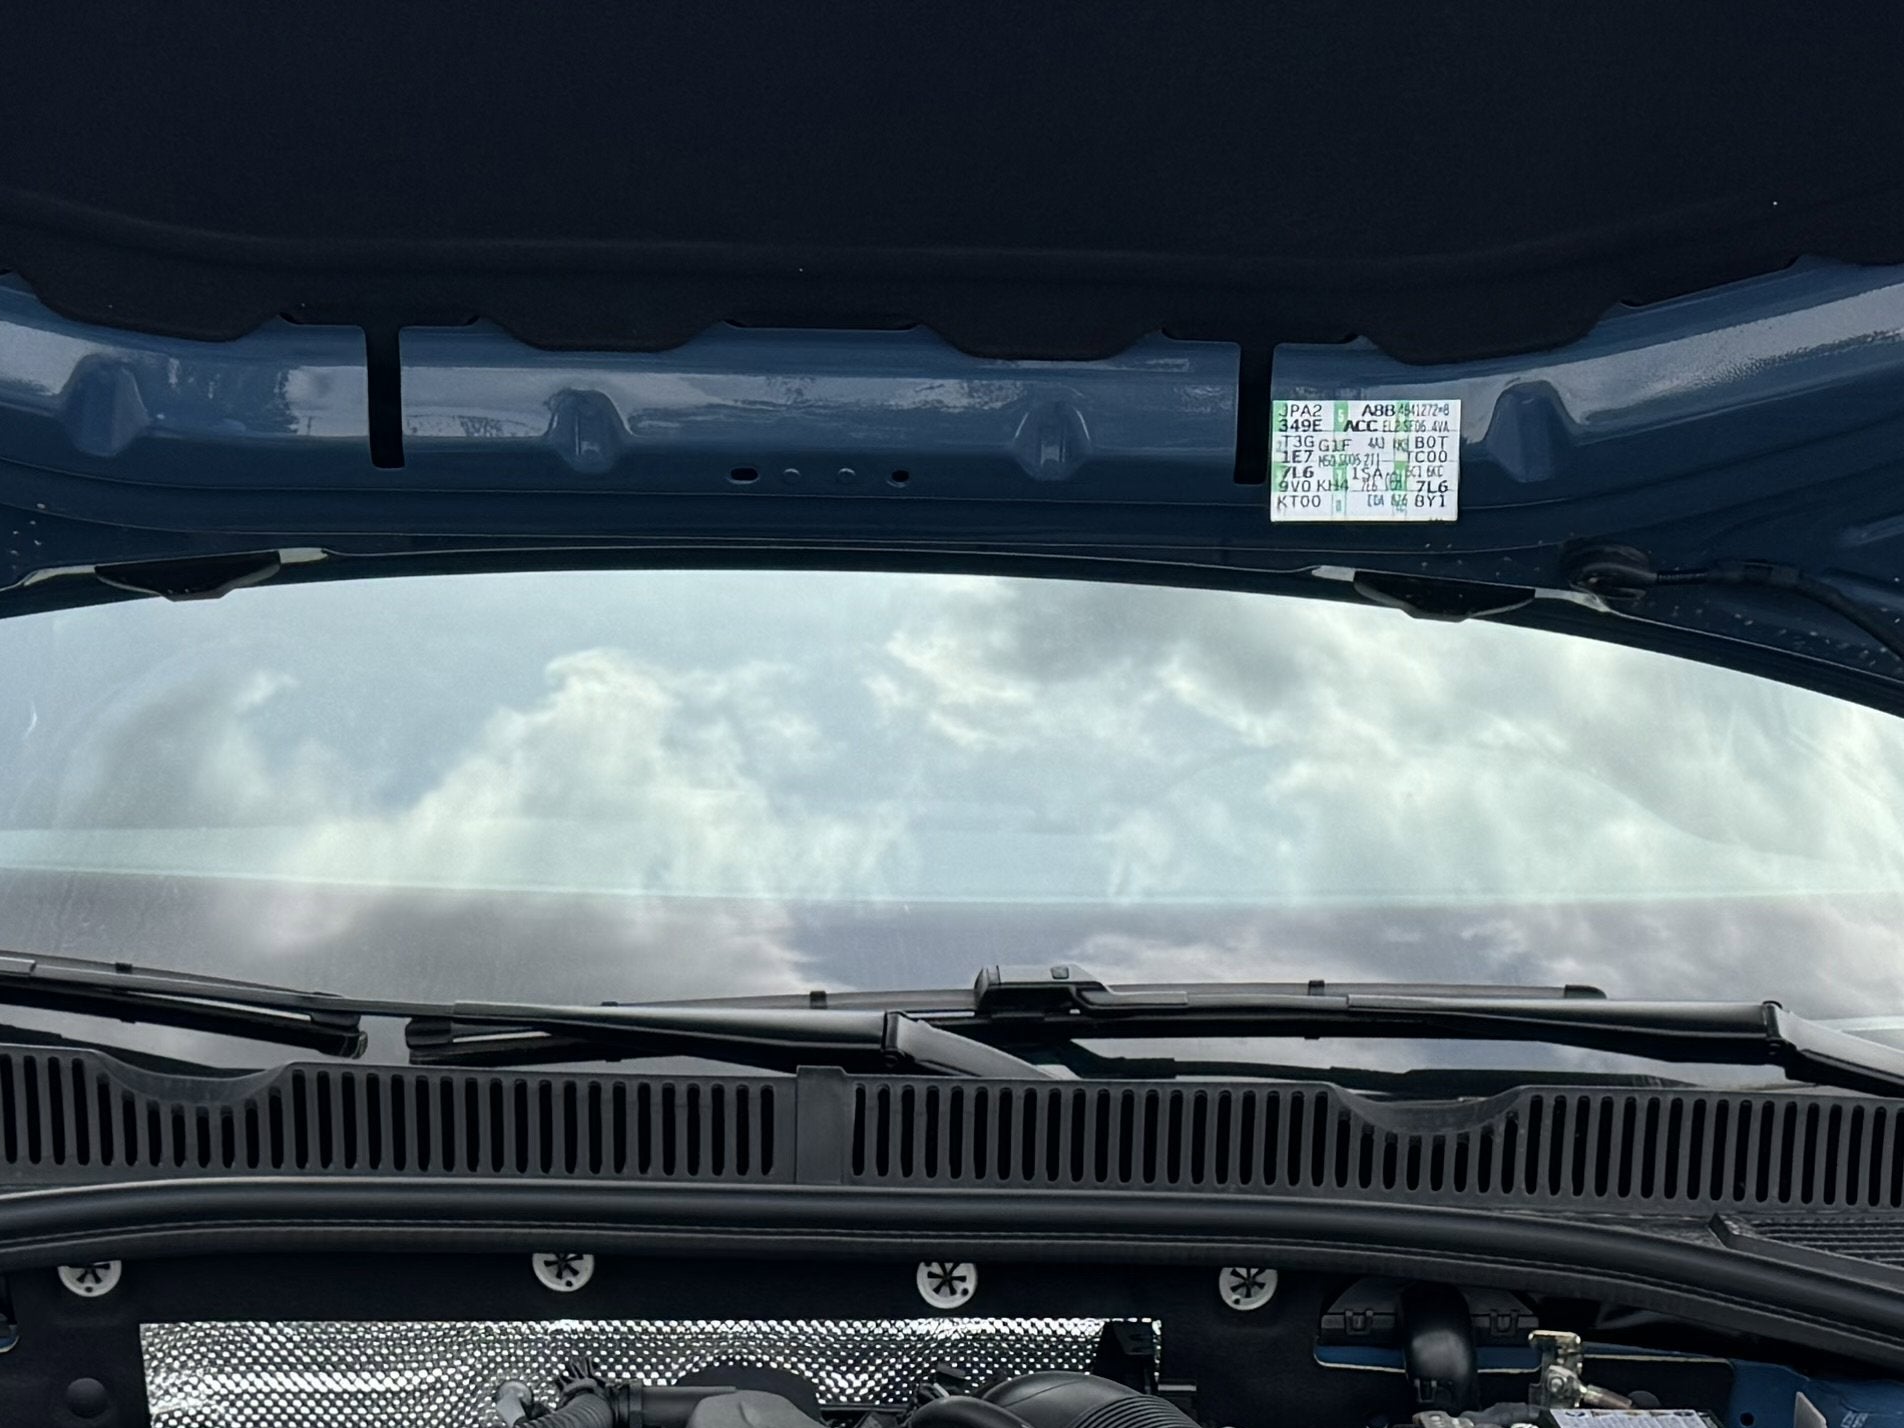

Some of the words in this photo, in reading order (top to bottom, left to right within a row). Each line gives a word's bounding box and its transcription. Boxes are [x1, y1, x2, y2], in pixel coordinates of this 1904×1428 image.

[1278, 403, 1322, 418] JPA2
[1278, 418, 1323, 433] 349E
[1343, 419, 1378, 433] ACC
[1281, 435, 1315, 448] T3G
[1318, 438, 1353, 452] G1F
[1281, 449, 1315, 463] 1E7
[1279, 465, 1315, 480] 7L6
[1416, 480, 1449, 493] 7L6
